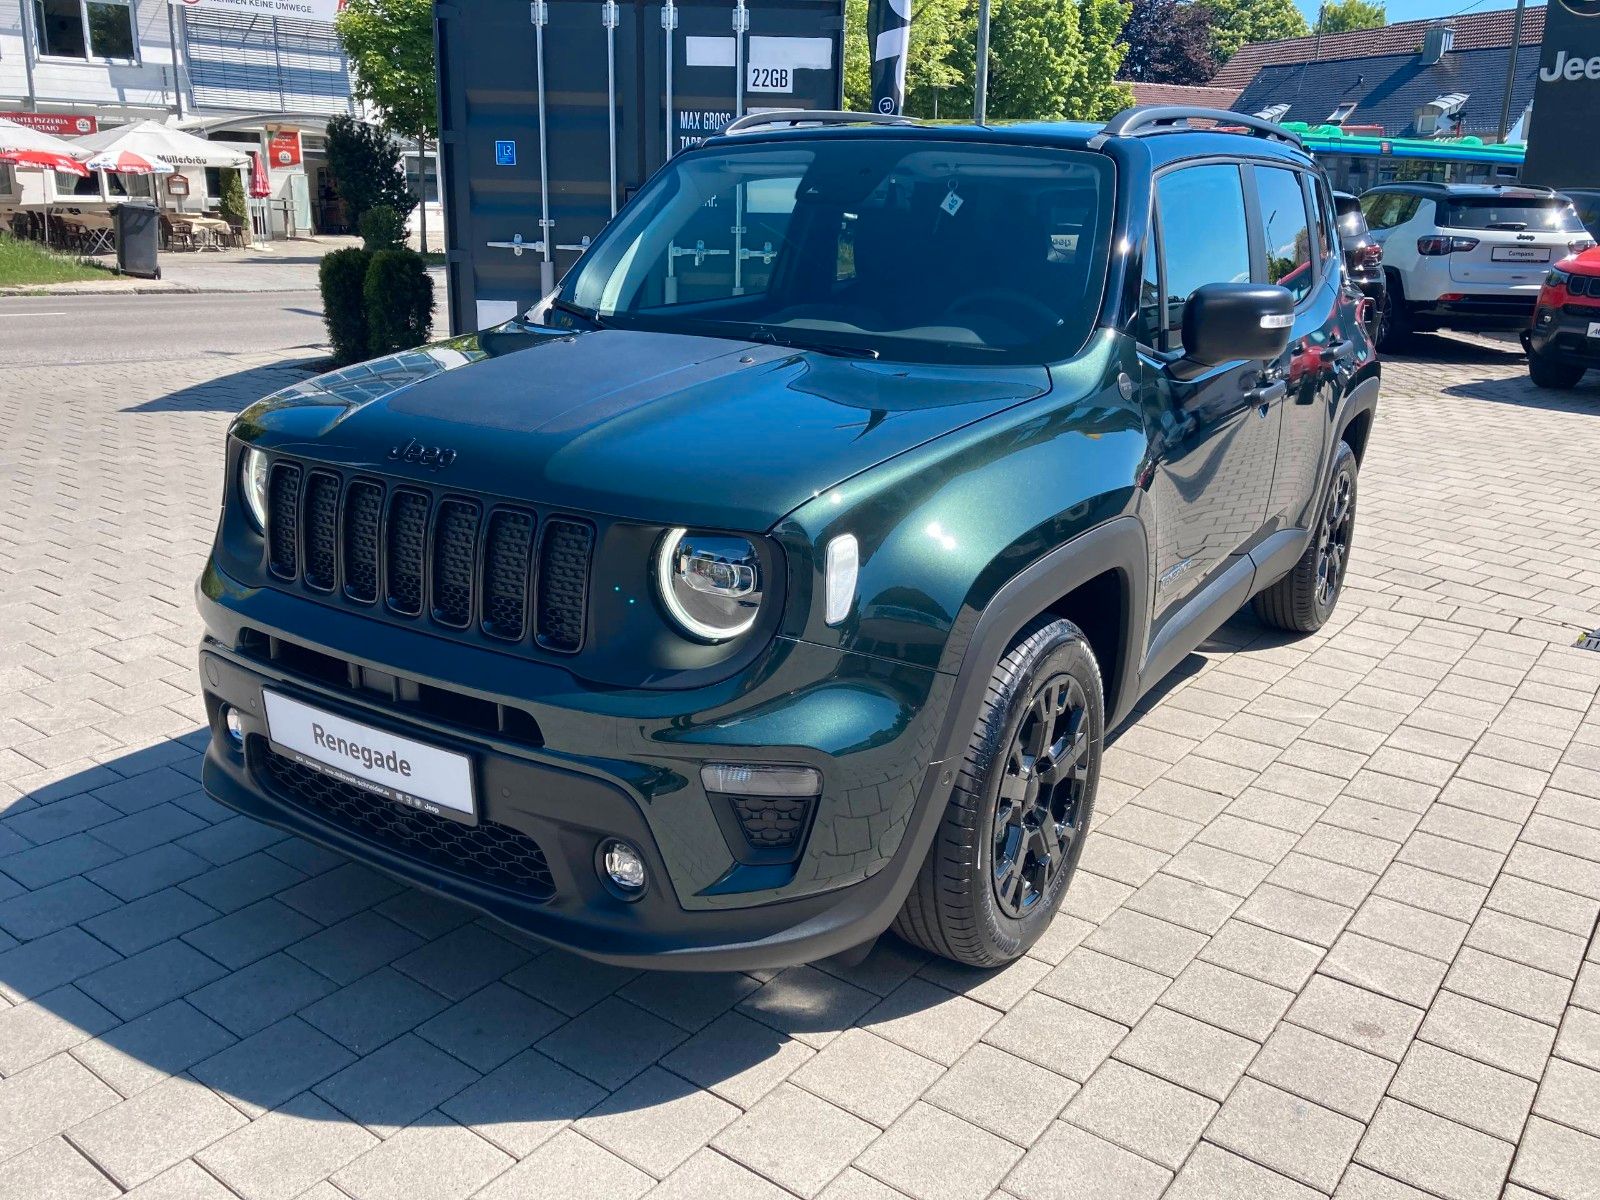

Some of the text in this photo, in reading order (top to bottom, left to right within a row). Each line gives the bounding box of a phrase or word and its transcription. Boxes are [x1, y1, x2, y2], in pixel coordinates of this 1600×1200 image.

[249, 0, 274, 8] KEINE
[752, 68, 788, 88] 22GB
[34, 116, 69, 125] PIZZERIA
[680, 111, 731, 130] MAX GROSS
[157, 154, 208, 165] Müllerbräu
[386, 437, 457, 473] Jeep
[312, 722, 411, 777] Renegade
[425, 803, 440, 814] Jeep
